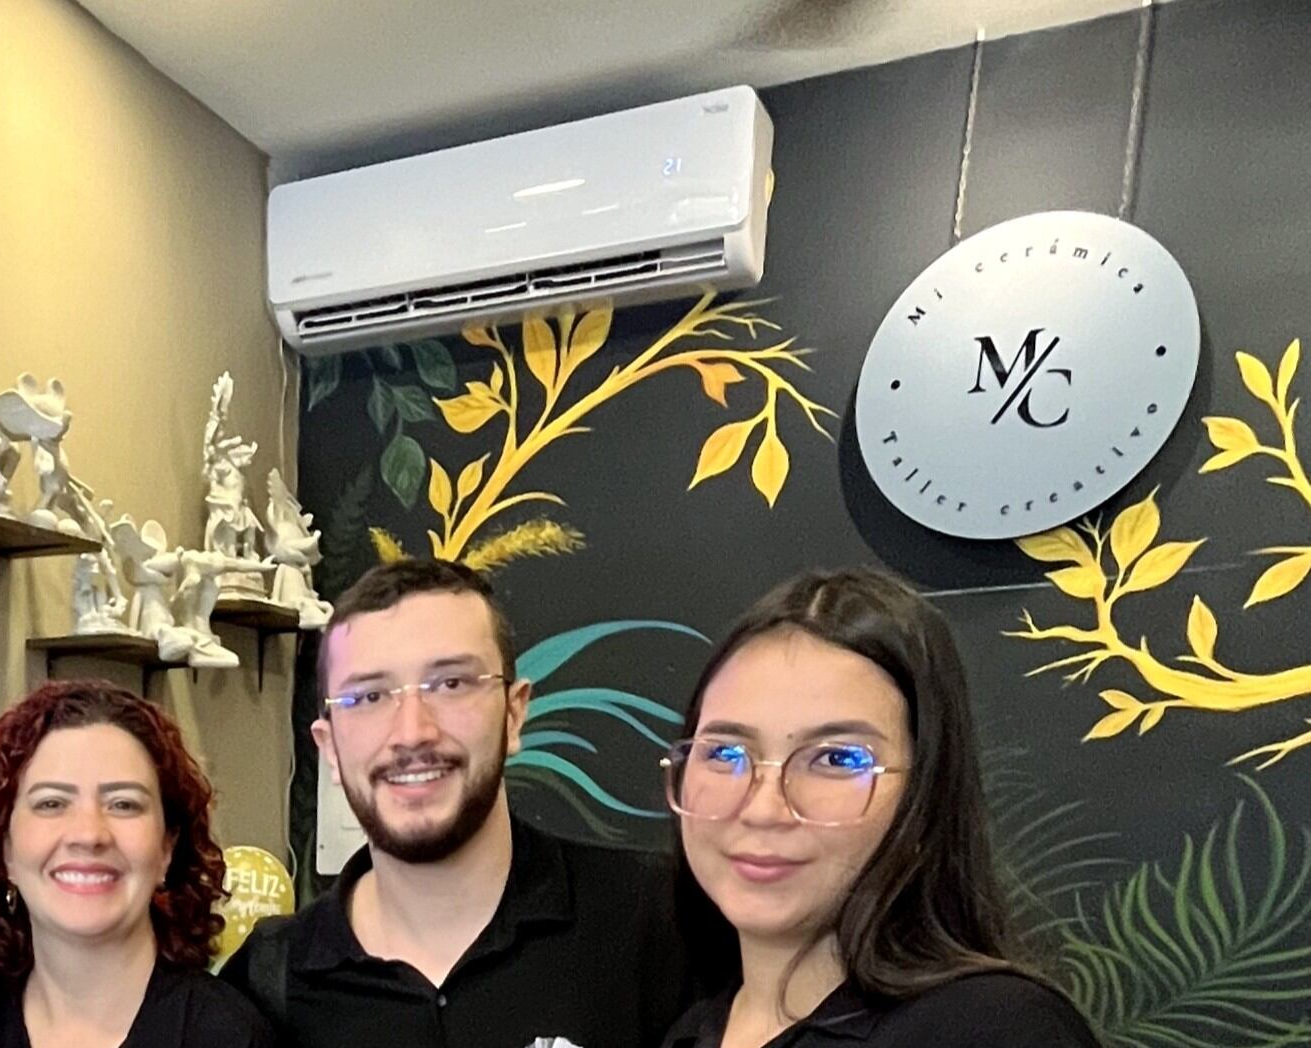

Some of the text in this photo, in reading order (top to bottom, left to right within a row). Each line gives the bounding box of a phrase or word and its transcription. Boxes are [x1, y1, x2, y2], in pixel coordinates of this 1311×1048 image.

[907, 238, 1145, 325] Mi cerámica
[882, 402, 1158, 516] Taller creativo
[226, 868, 281, 898] FELIZ
